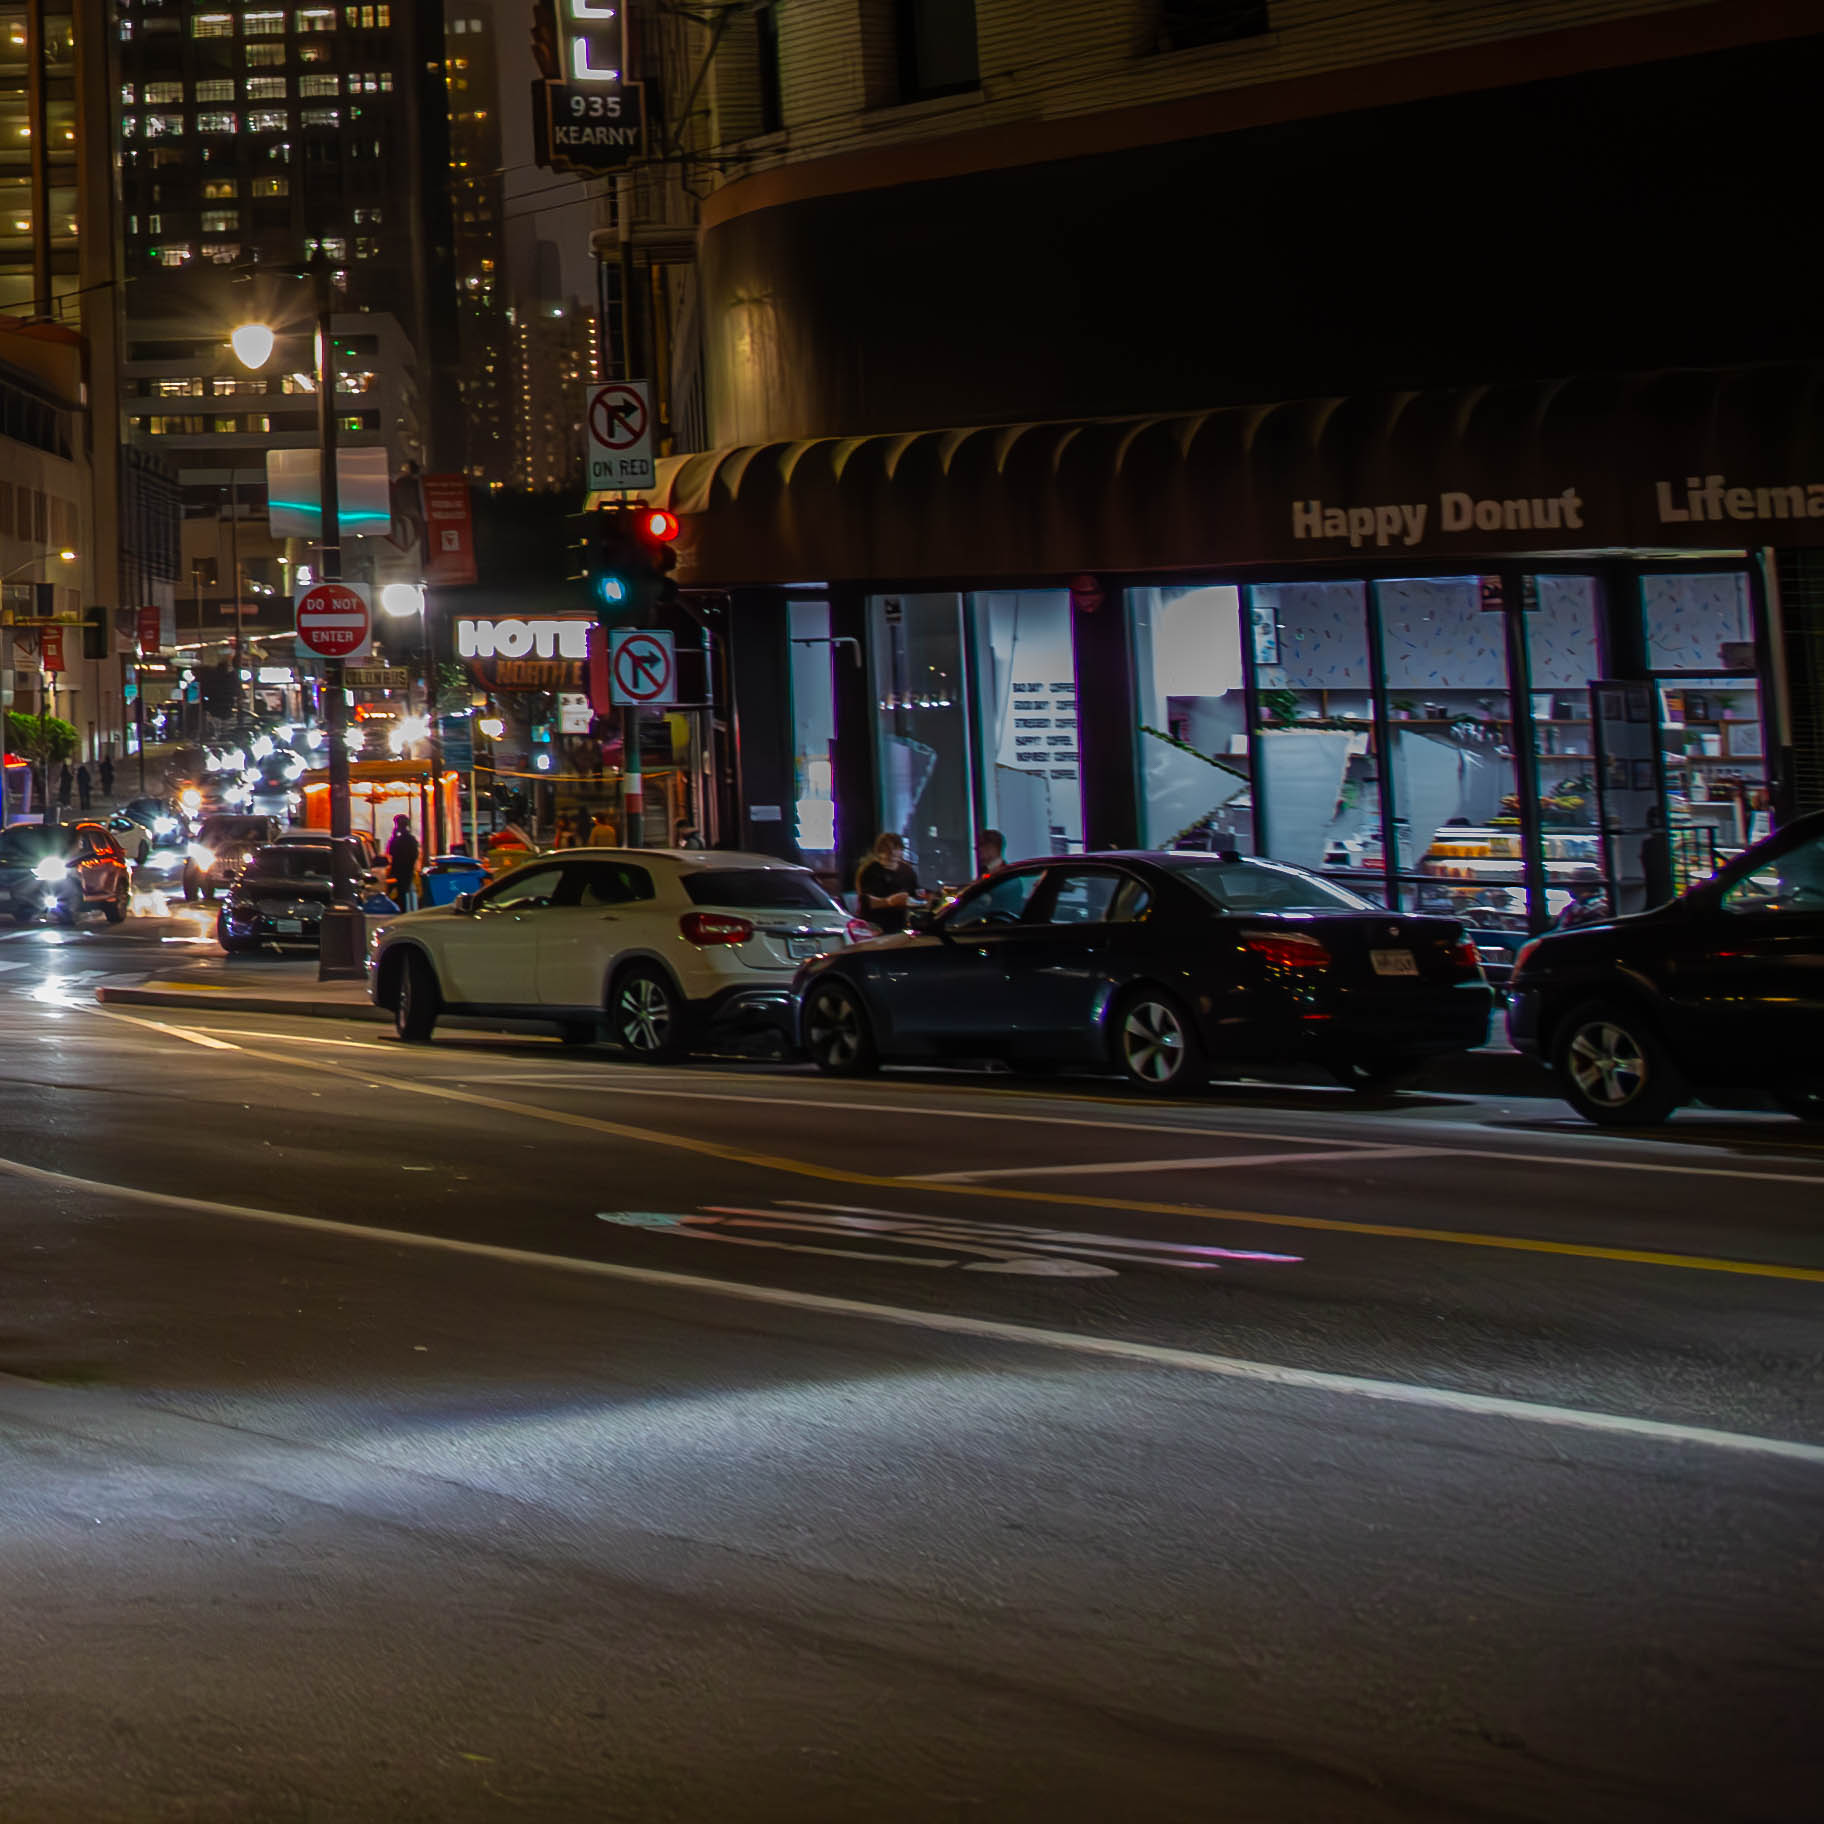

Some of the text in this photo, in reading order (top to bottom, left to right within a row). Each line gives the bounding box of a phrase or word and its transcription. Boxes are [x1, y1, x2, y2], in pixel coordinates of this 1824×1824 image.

[570, 95, 623, 119] 935
[554, 123, 639, 147] KEARNY
[592, 459, 650, 478] ON RED
[1290, 498, 1428, 548] Happy
[1439, 486, 1584, 532] Donut
[306, 598, 358, 611] DO NOT
[311, 630, 354, 643] ENTER
[458, 619, 591, 658] HOTE
